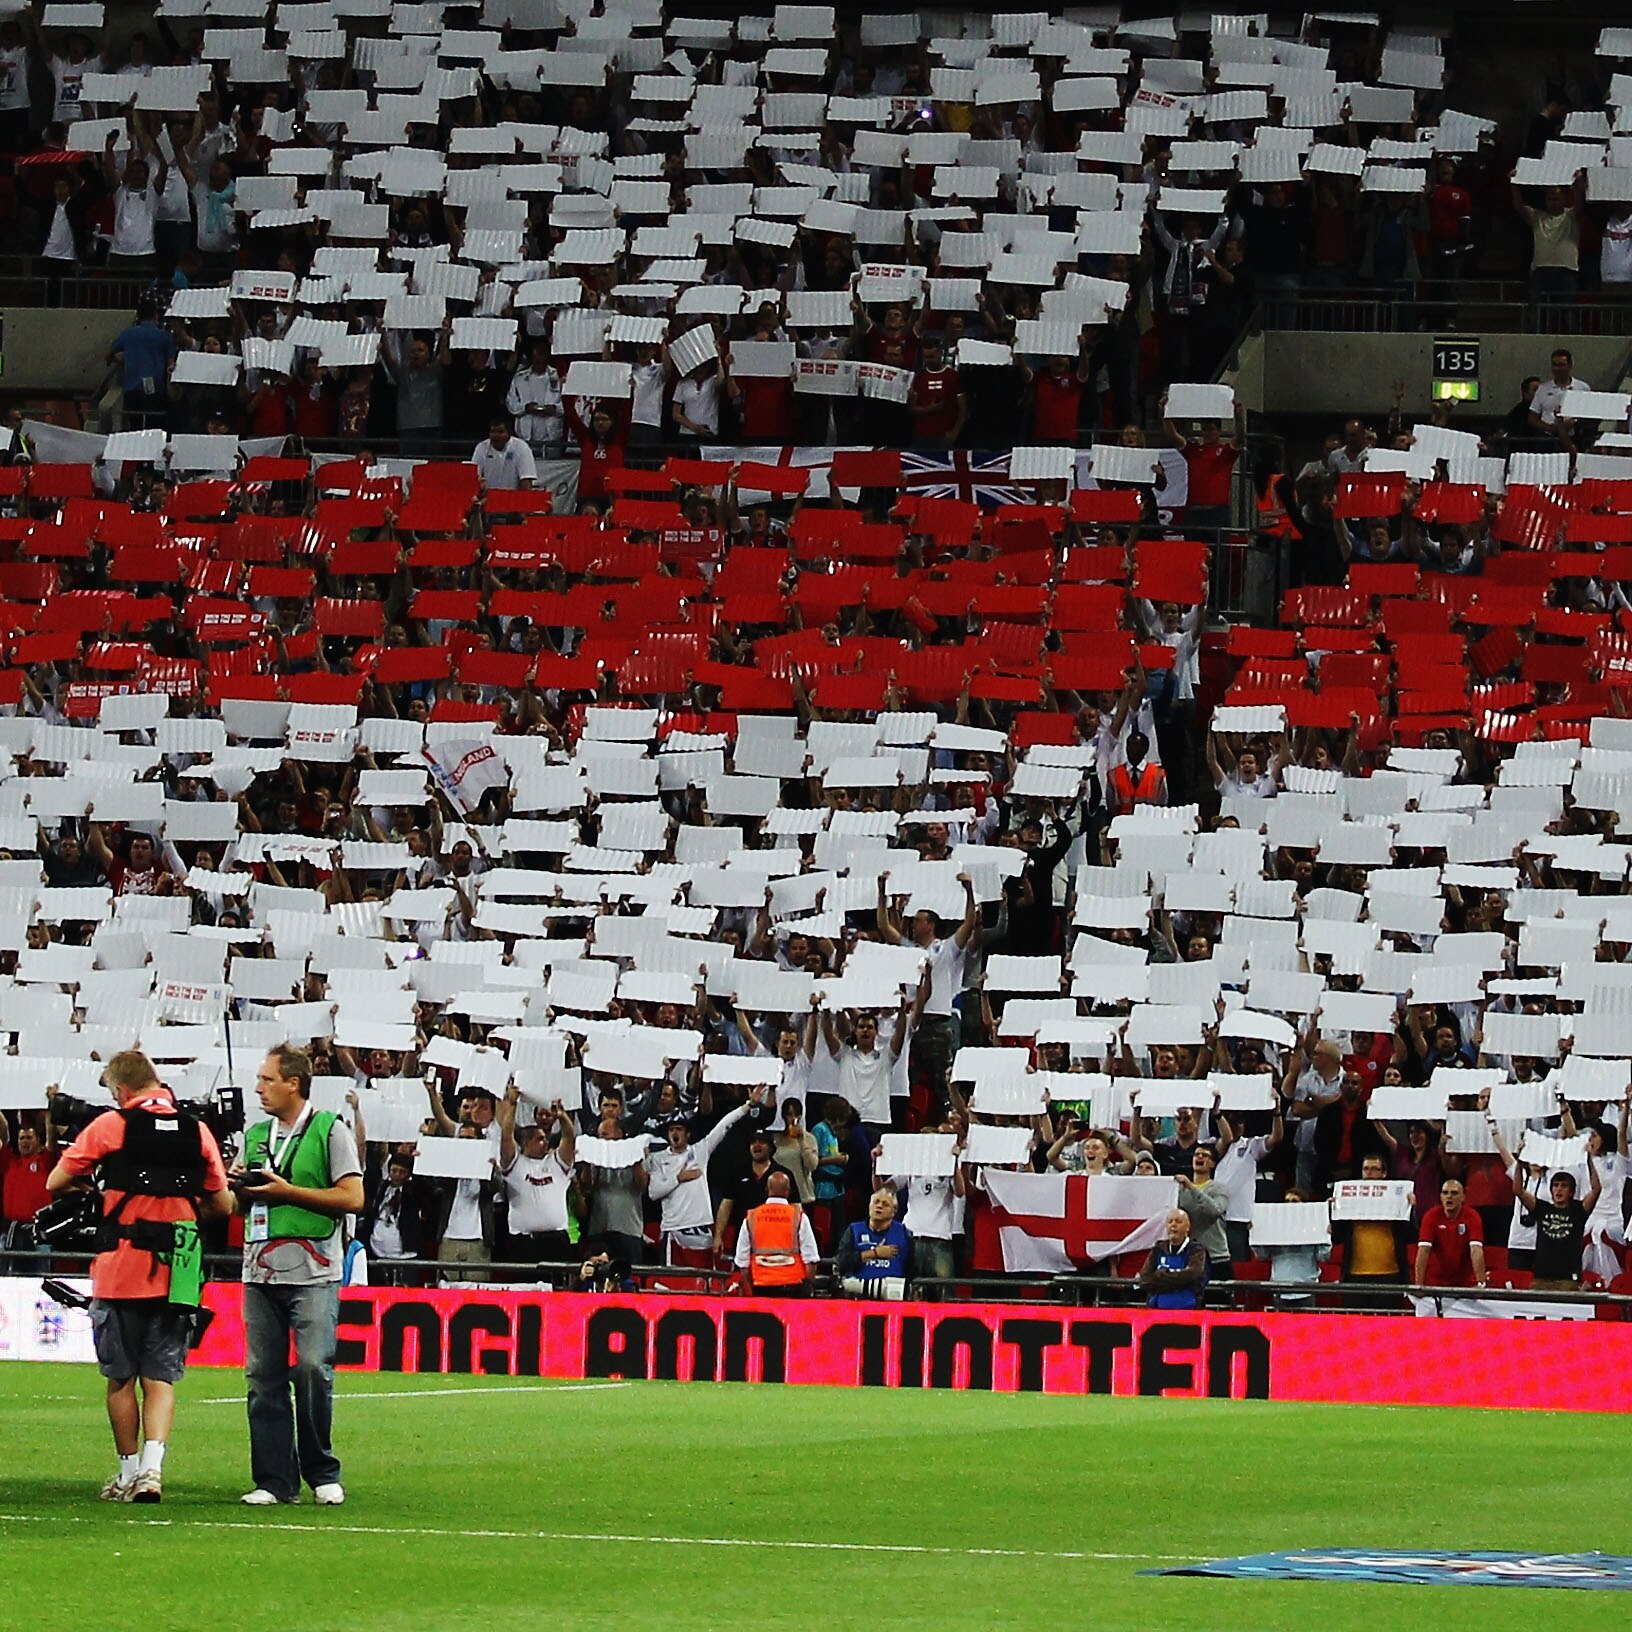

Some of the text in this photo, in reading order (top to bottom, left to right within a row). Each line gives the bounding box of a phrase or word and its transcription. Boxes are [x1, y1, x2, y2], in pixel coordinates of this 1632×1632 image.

[1436, 351, 1476, 371] 135
[593, 448, 608, 460] 66
[924, 1183, 933, 1196] 9
[174, 1253, 191, 1268] TV
